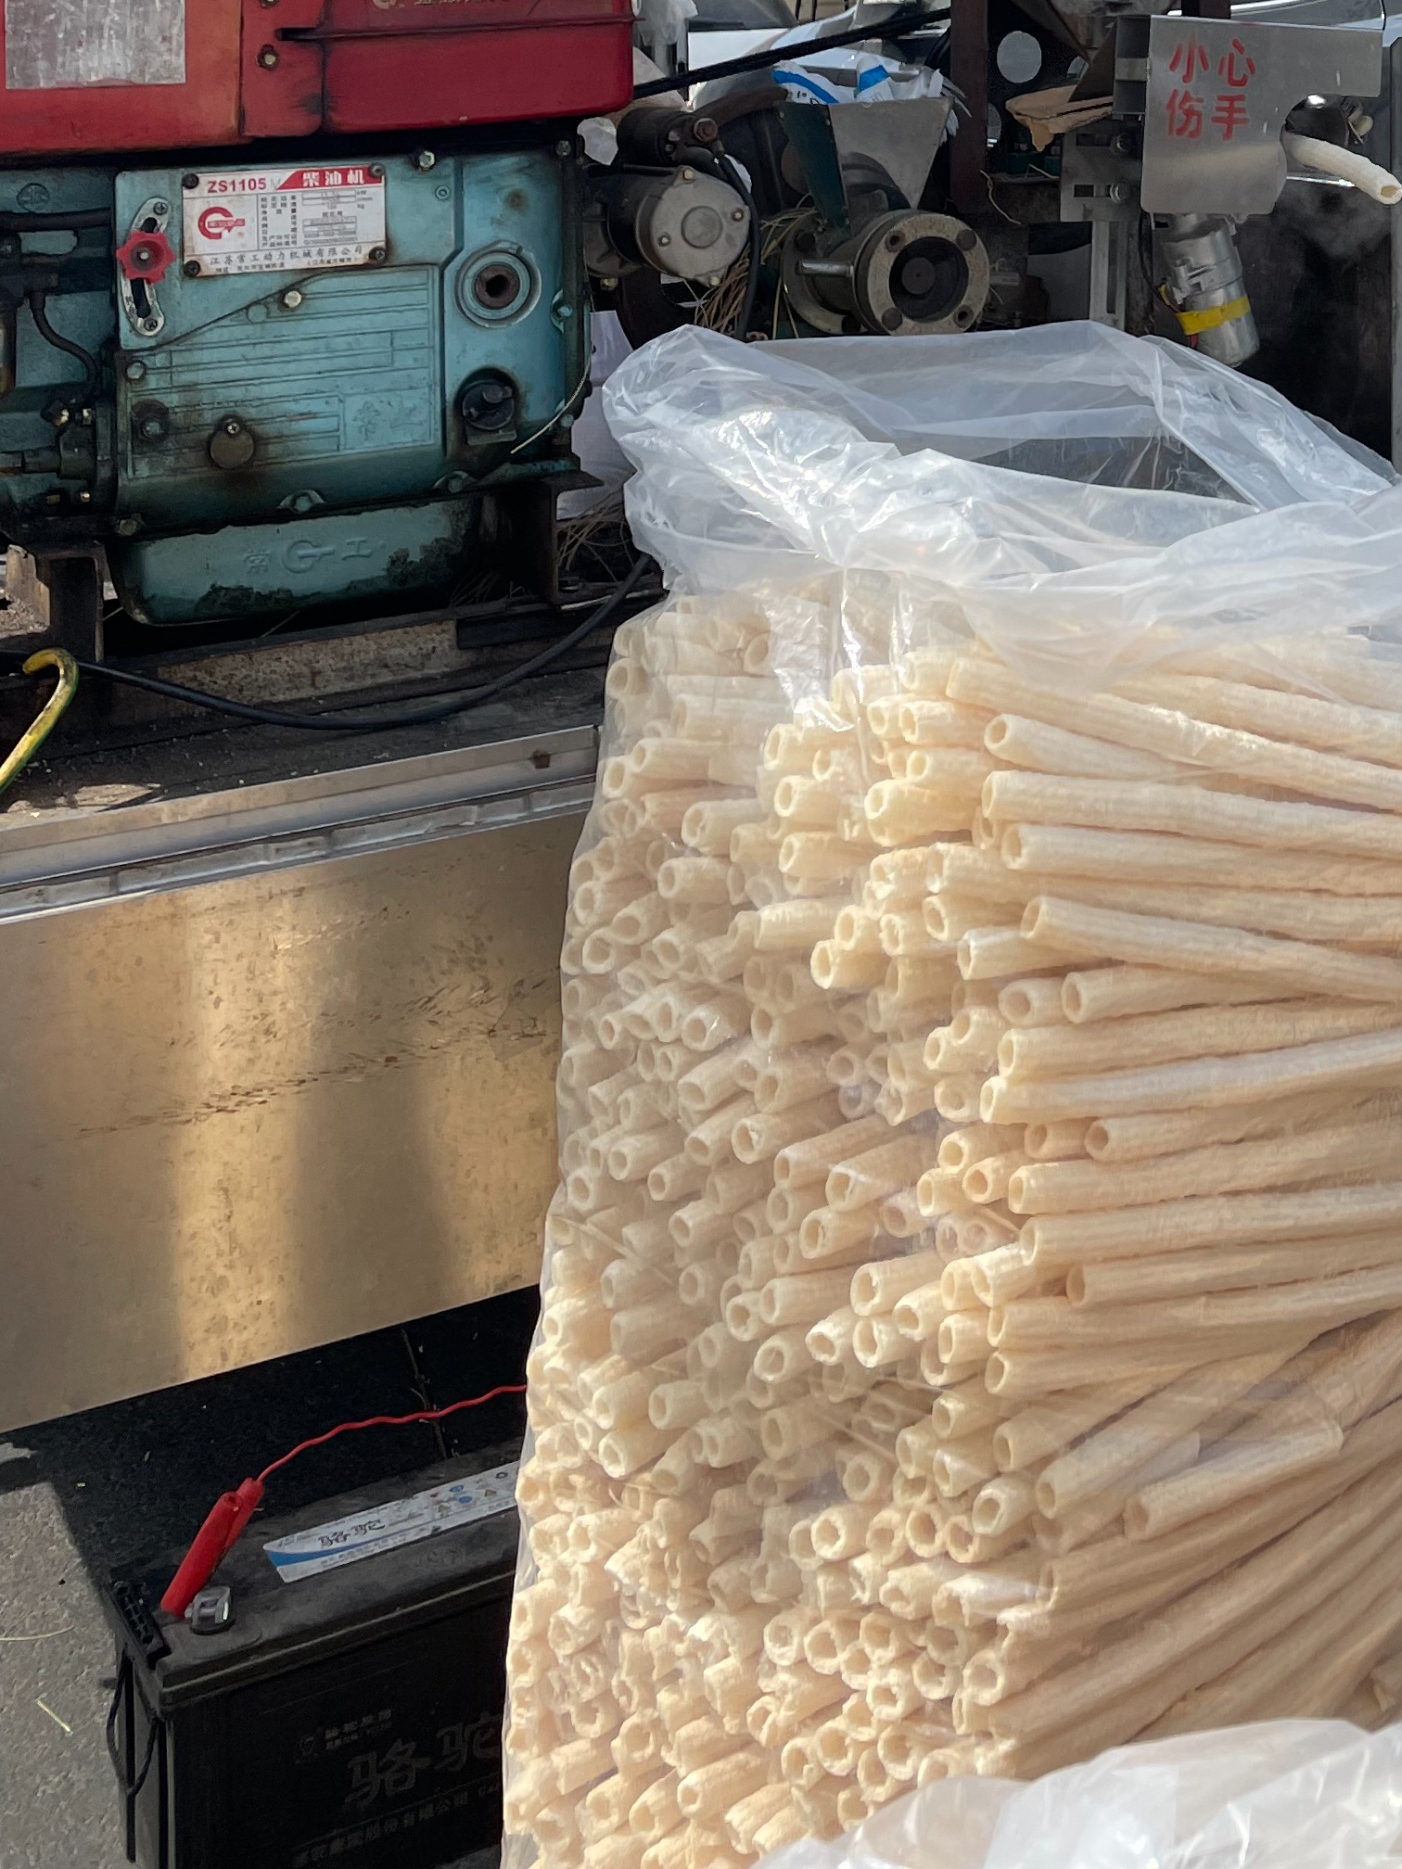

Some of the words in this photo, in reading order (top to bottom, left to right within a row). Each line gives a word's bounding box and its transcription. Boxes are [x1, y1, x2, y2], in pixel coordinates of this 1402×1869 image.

[1169, 33, 1256, 87] 小心
[1166, 88, 1250, 142] 伤手
[207, 177, 267, 194] ZS1105
[302, 170, 366, 187] 柴油机
